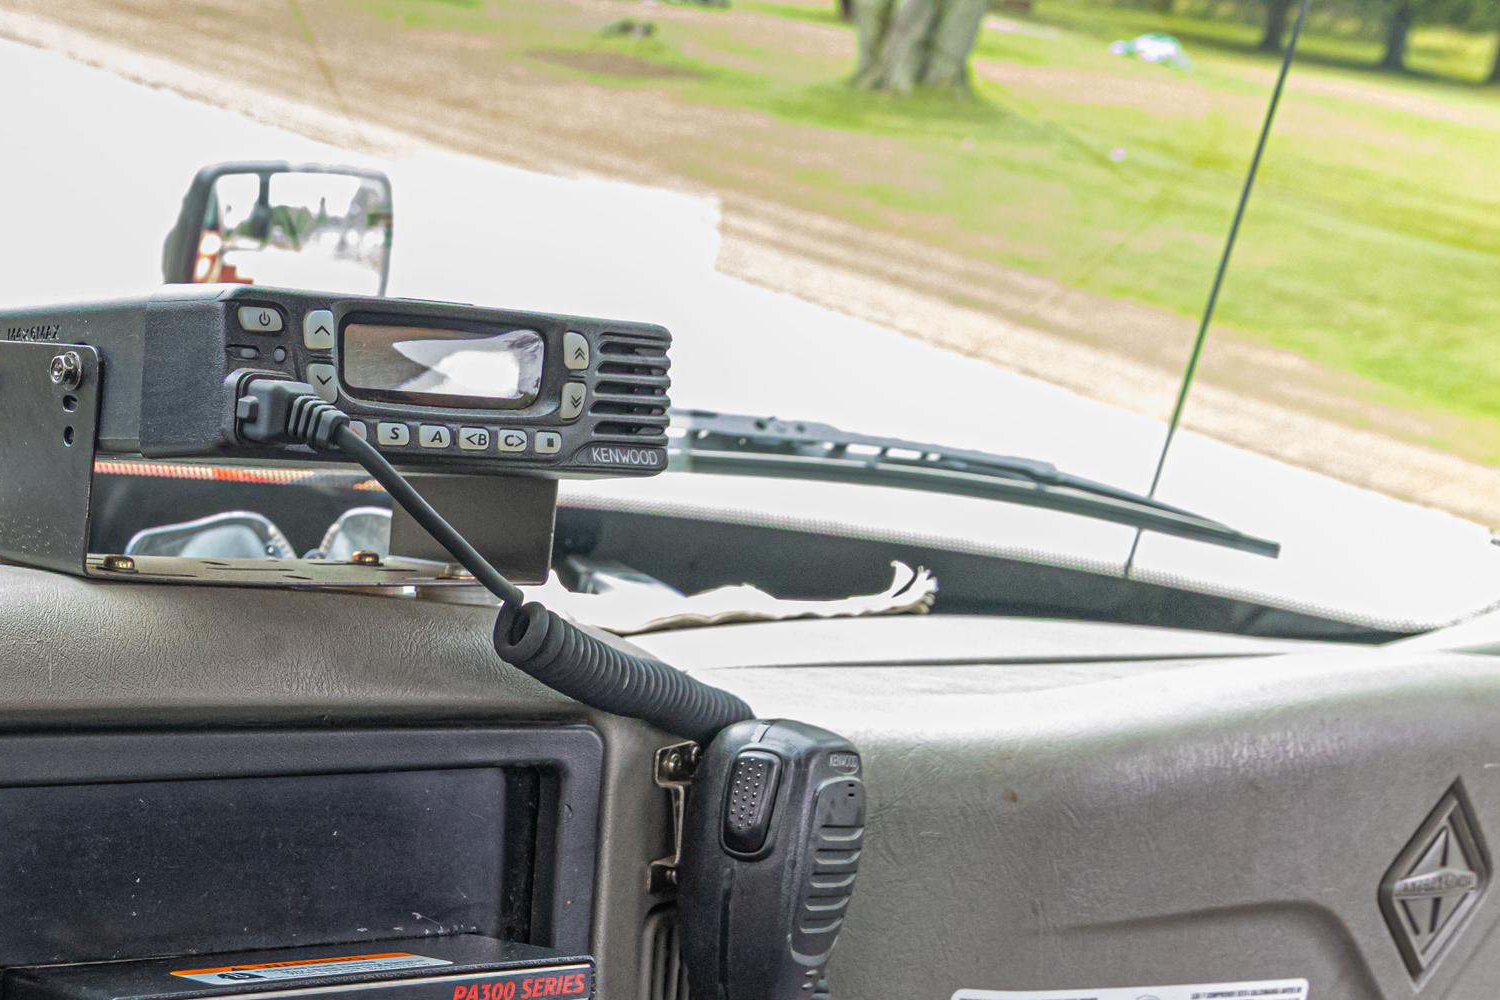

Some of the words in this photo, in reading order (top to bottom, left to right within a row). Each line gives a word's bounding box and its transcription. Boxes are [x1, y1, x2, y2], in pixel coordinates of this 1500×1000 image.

[389, 427, 400, 440] S
[430, 430, 443, 443] A
[591, 447, 659, 466] KENWOOD
[520, 973, 586, 999] SERIES
